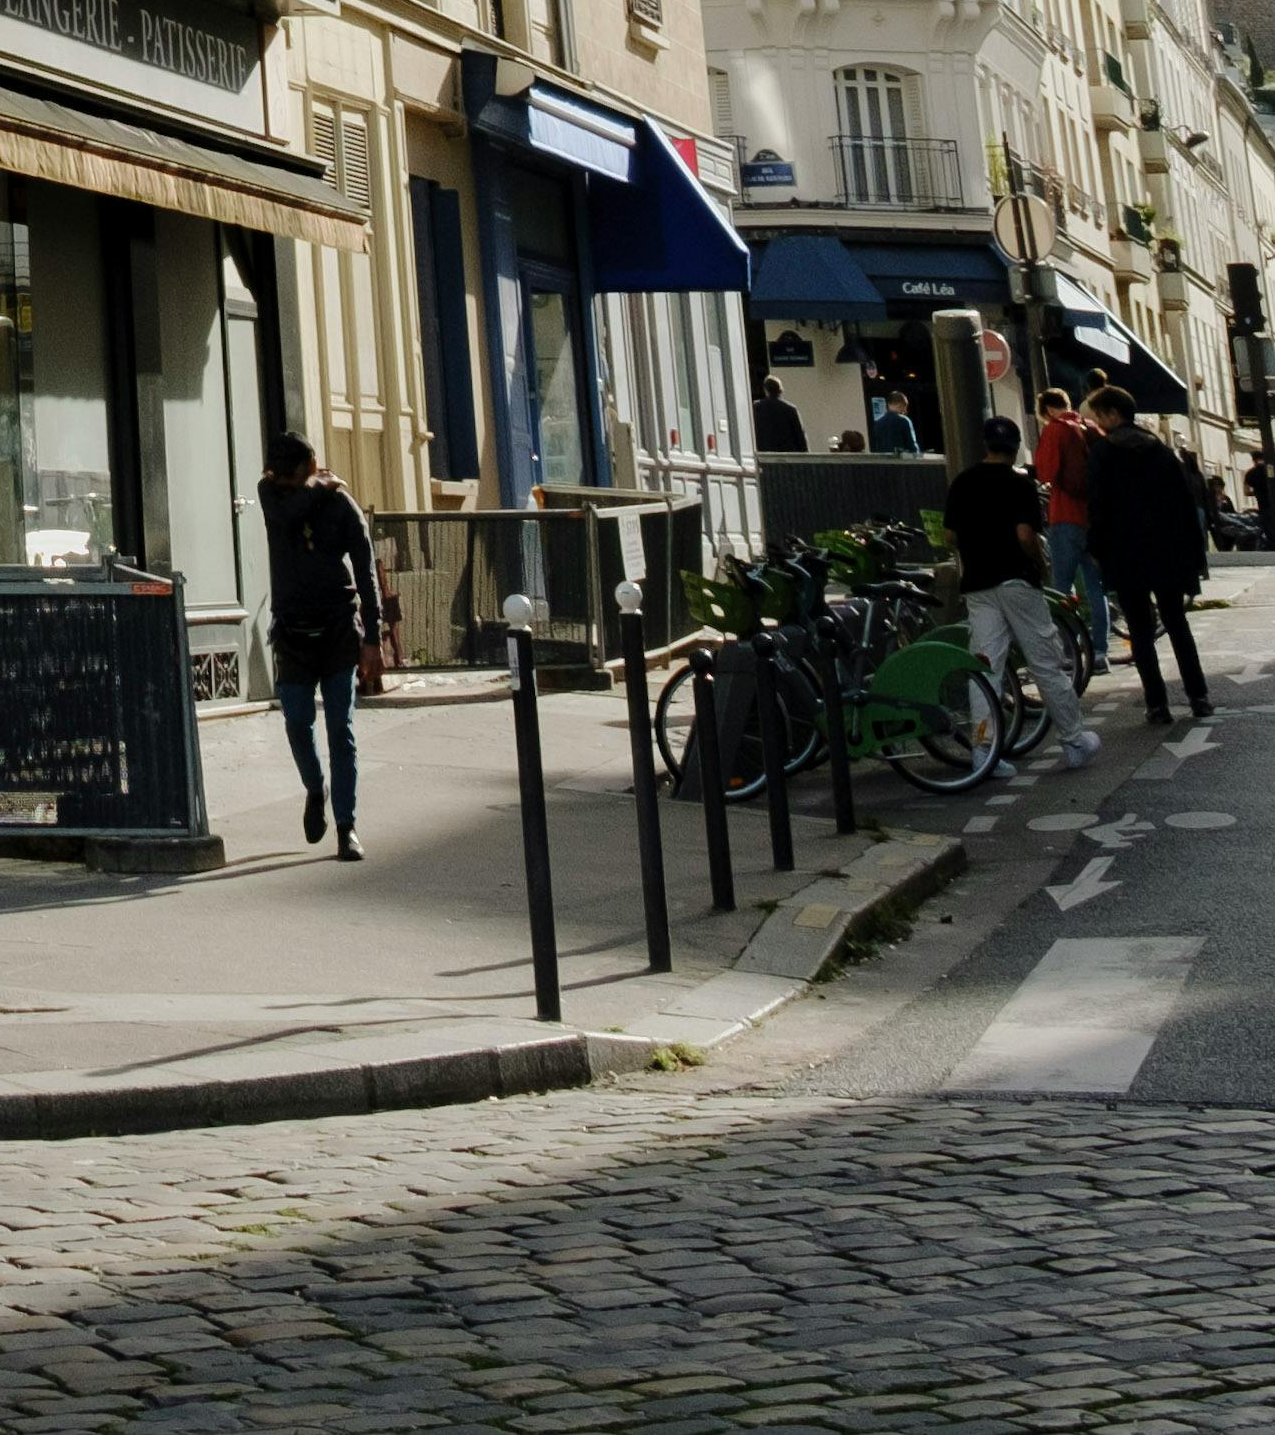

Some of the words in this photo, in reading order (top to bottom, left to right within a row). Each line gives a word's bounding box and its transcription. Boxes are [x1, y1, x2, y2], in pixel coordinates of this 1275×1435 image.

[141, 9, 247, 93] PATISSERIE
[902, 281, 930, 295] Café
[932, 282, 956, 296] Léa
